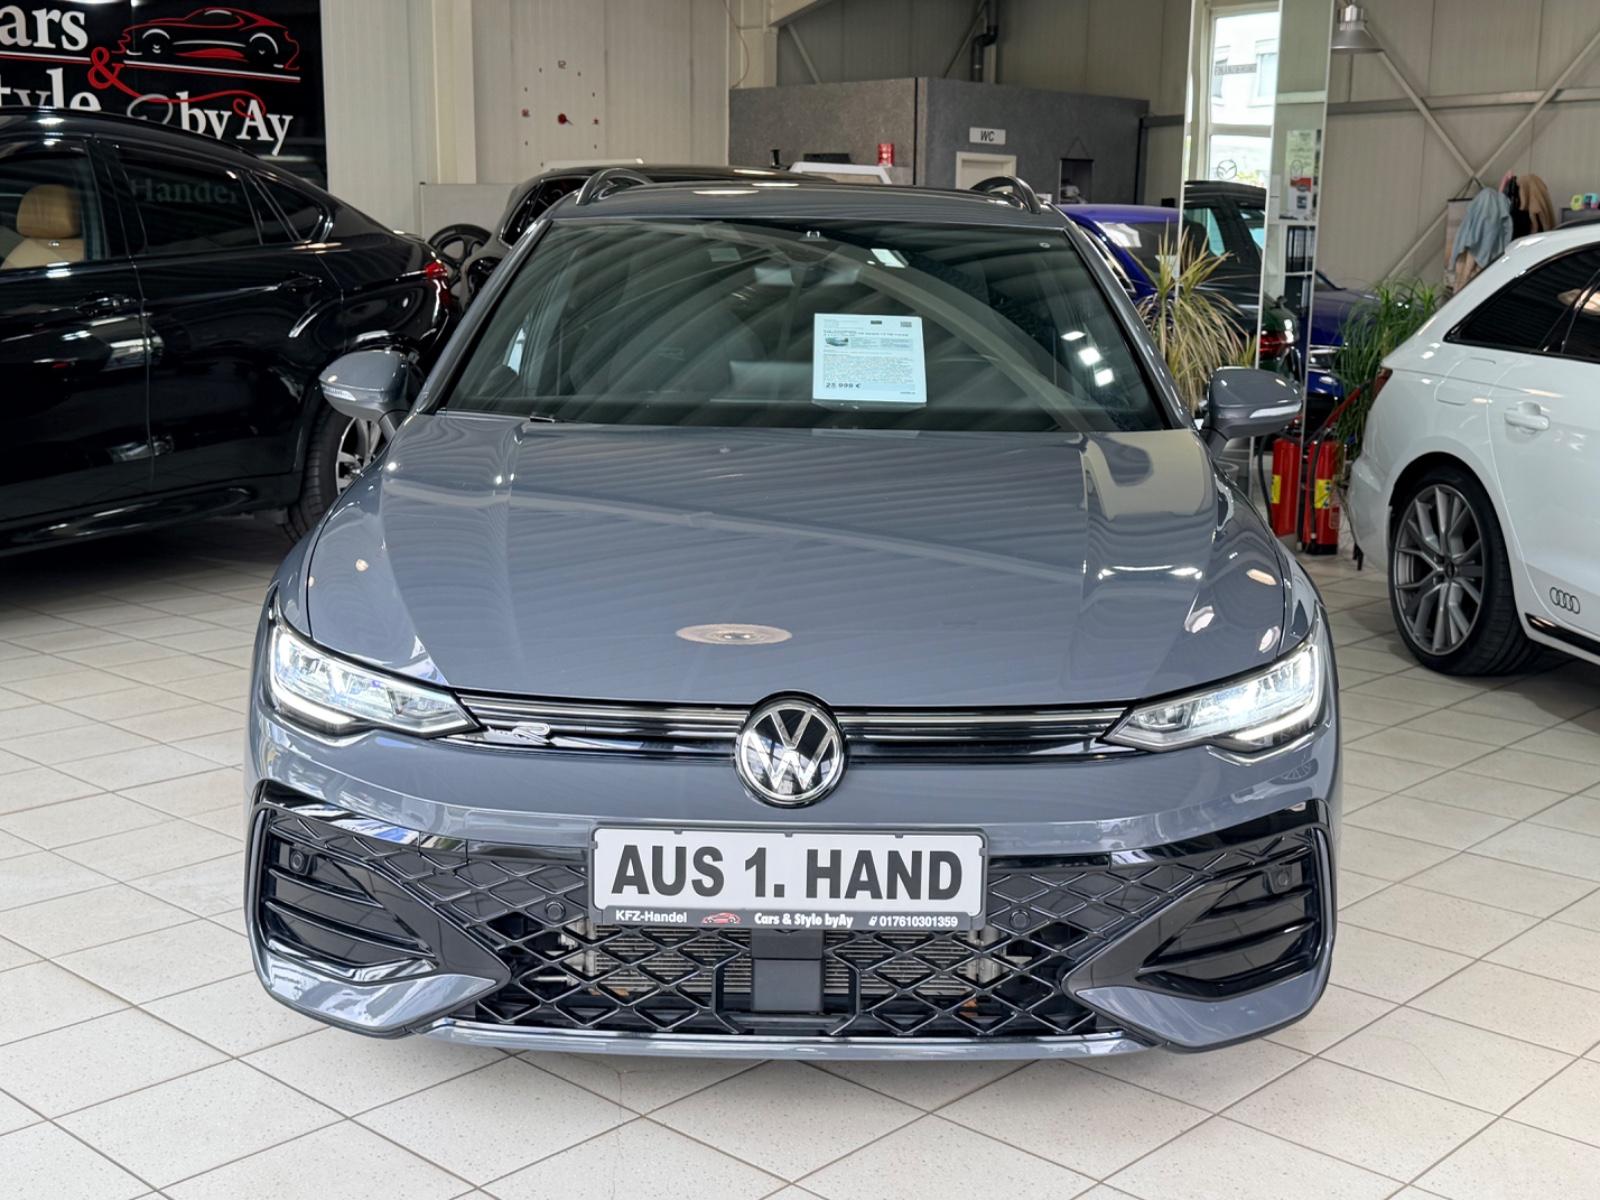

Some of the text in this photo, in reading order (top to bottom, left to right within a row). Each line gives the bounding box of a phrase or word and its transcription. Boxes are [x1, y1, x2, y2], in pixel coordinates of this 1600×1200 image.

[0, 5, 88, 51] ars
[87, 46, 125, 89] &
[236, 99, 293, 156] Ay
[980, 130, 995, 141] WC
[611, 845, 962, 900] AUS 1. HAND
[615, 910, 687, 923] KFZ-Handel
[754, 912, 780, 925] Cars
[782, 913, 792, 925] &
[825, 912, 854, 929] byAy
[879, 915, 958, 928] 017610301359
